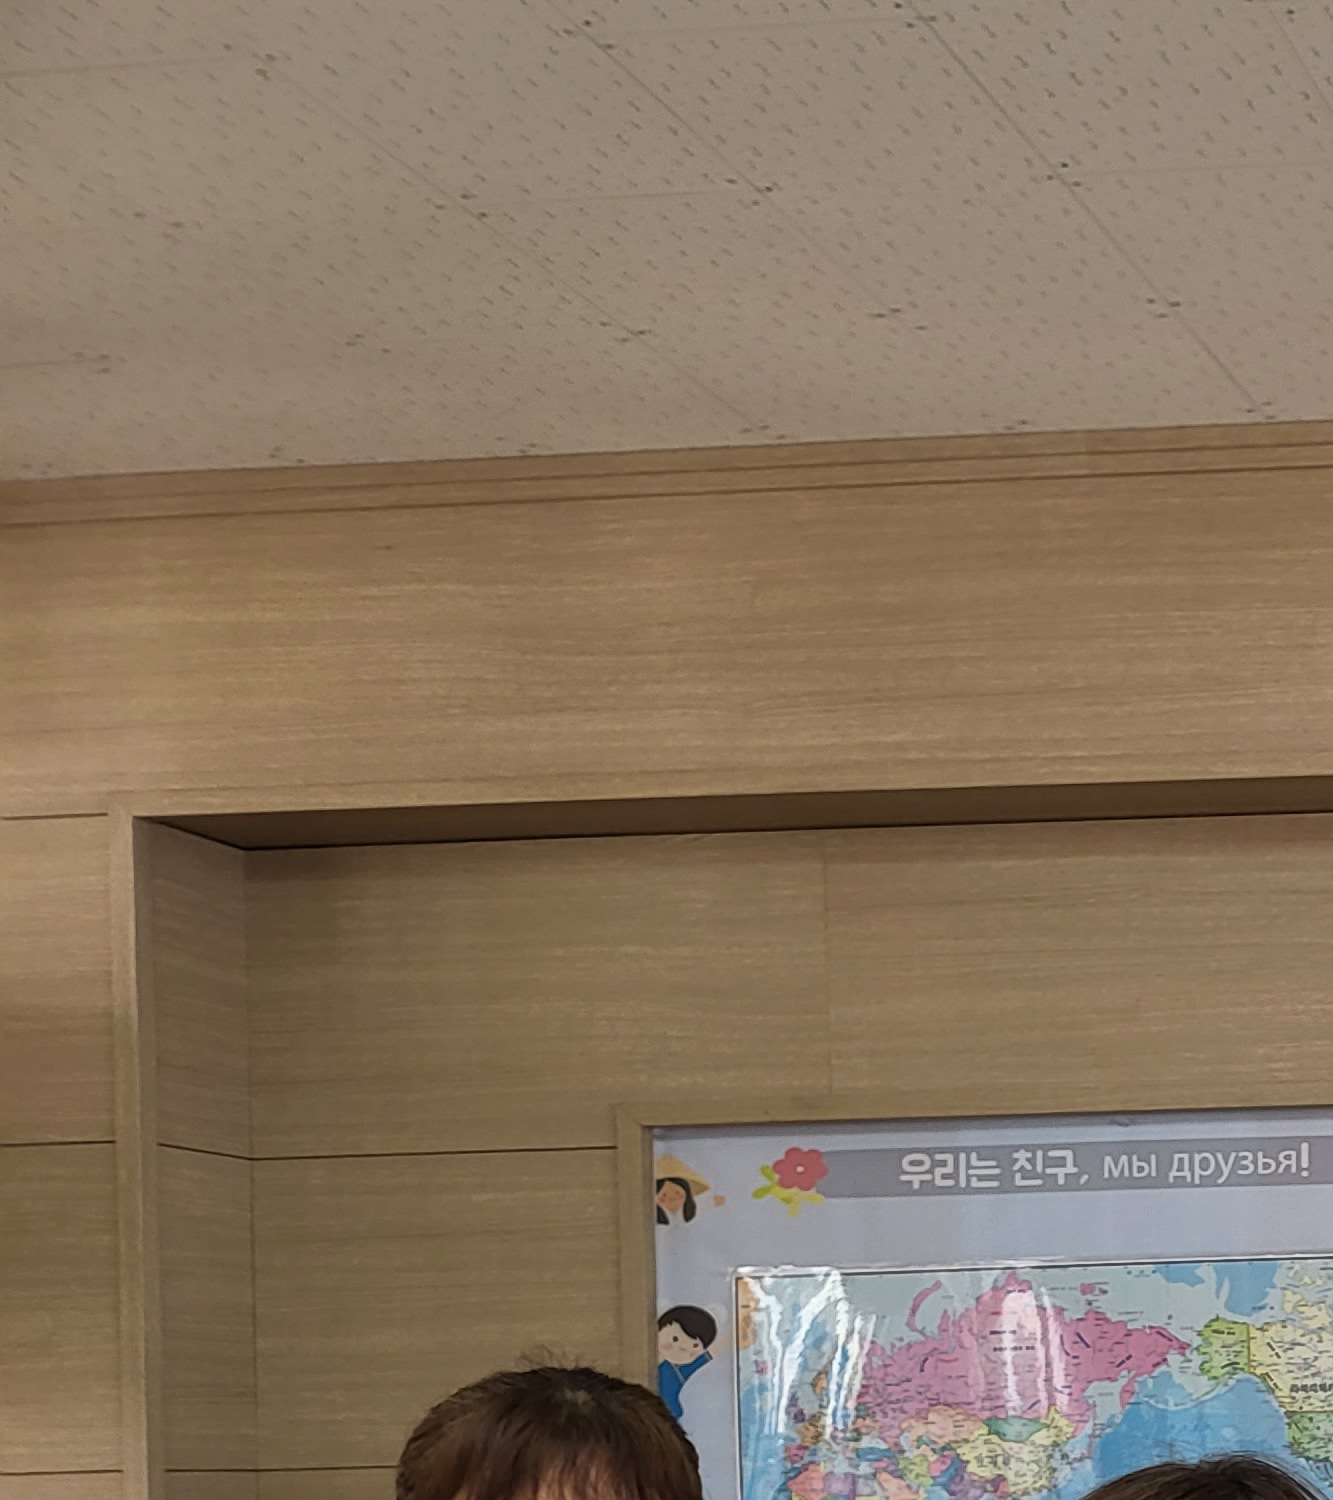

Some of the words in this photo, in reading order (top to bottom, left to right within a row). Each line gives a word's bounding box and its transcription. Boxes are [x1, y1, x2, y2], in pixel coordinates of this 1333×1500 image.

[899, 1151, 1002, 1189] 우리는
[1012, 1149, 1089, 1187] 친구,
[1103, 1153, 1157, 1179] мы
[1168, 1142, 1310, 1184] друзья!
